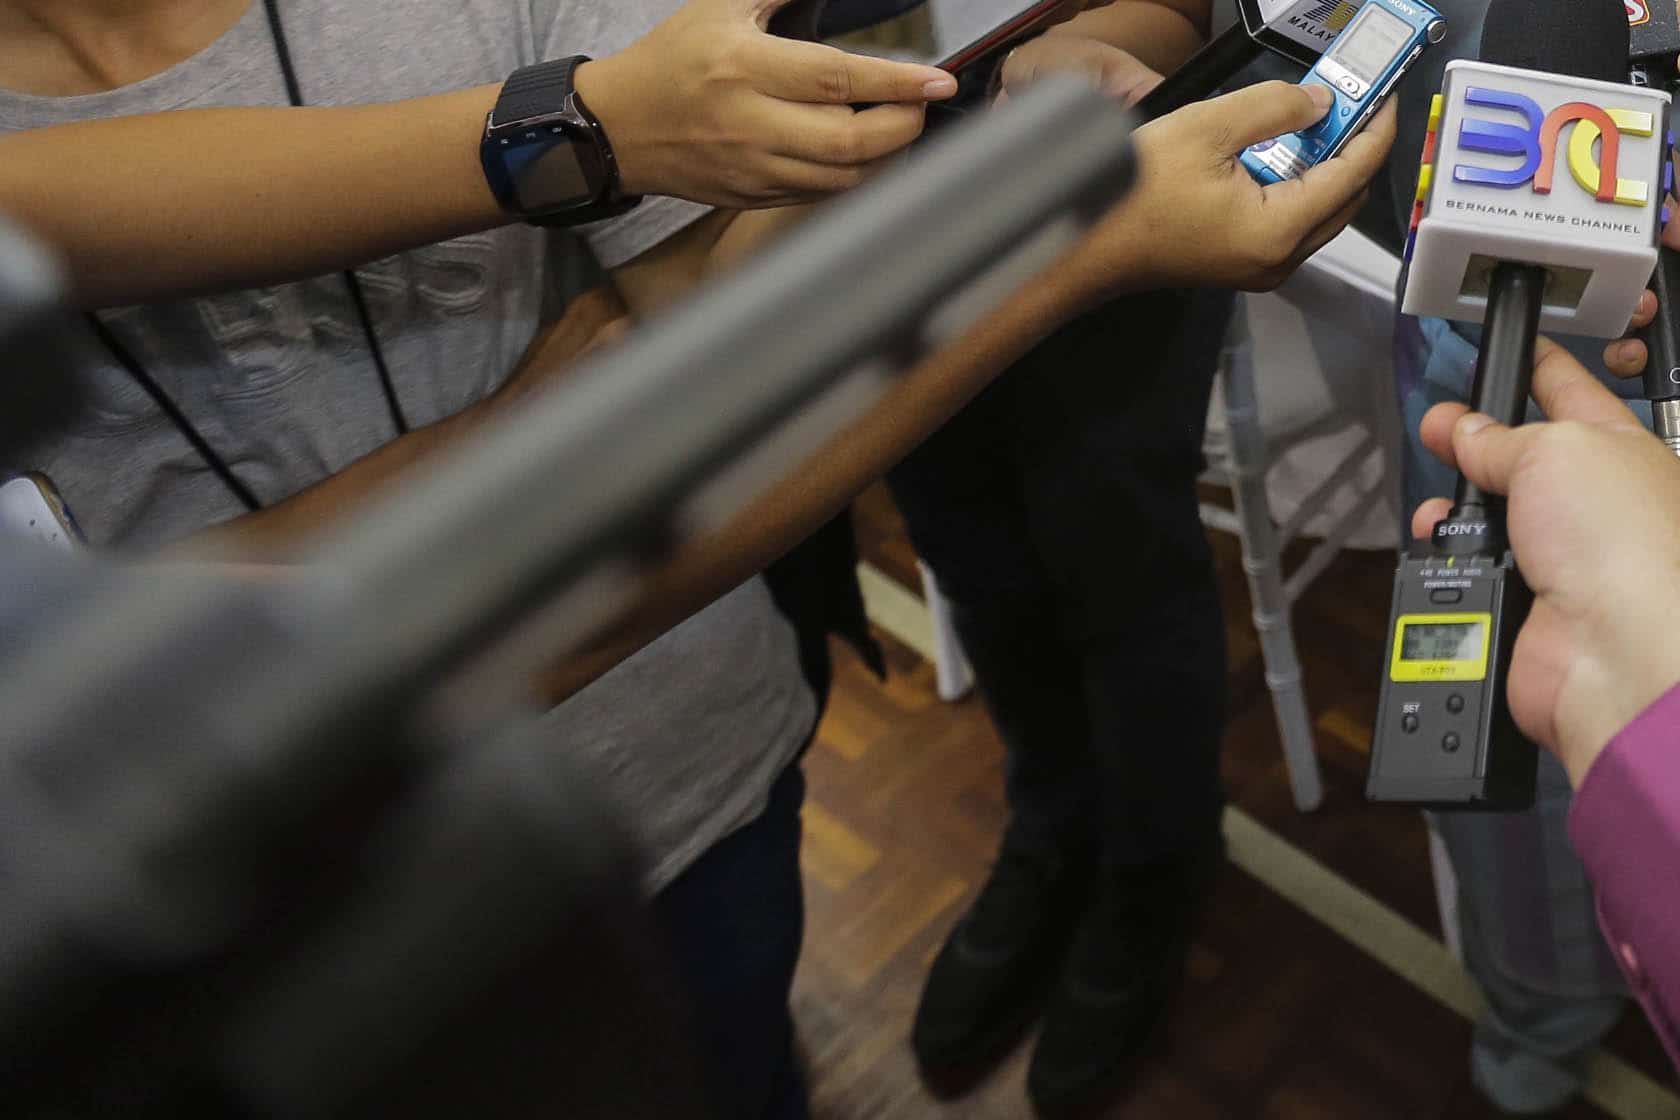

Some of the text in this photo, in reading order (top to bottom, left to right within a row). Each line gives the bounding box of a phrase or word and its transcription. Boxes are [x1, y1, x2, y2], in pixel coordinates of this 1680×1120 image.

[1288, 15, 1336, 42] MALAY
[1445, 200, 1641, 235] BERNAMA NEWS CHANNEL
[1438, 523, 1489, 537] SONY
[1402, 703, 1420, 714] SET
